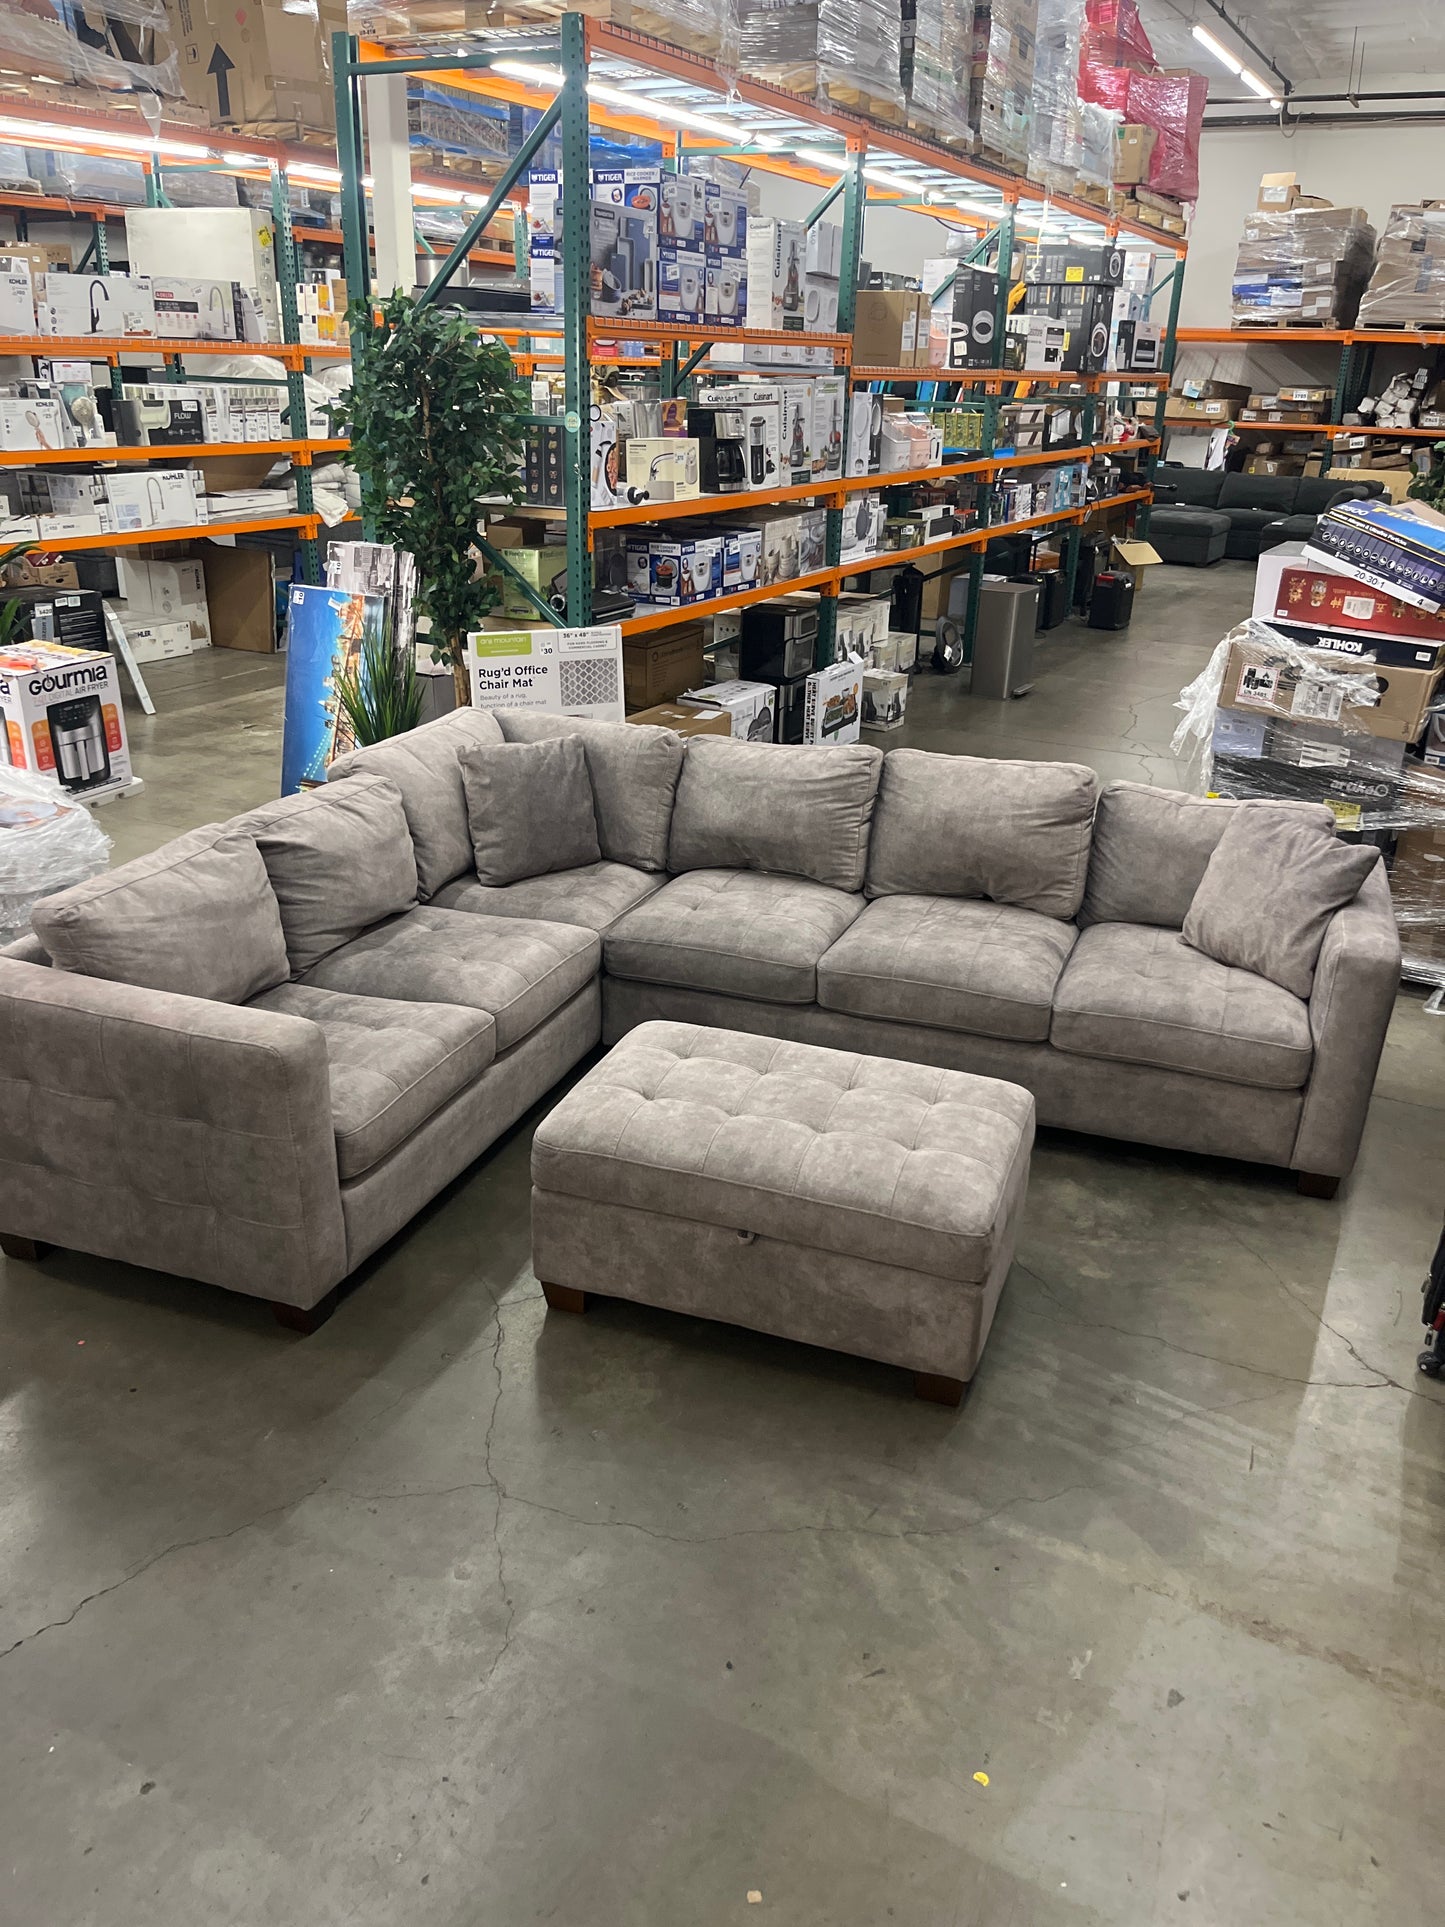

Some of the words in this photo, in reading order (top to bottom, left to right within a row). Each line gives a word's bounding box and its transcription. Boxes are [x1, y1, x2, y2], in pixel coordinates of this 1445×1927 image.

[774, 223, 782, 278] Cuisinart
[707, 394, 738, 402] Cuisinart
[753, 392, 773, 401] Cuisinart
[173, 412, 191, 420] FLOW
[298, 592, 304, 600] 10
[1318, 636, 1362, 653] KOHLER
[478, 668, 511, 679] Rug'd
[514, 665, 548, 676] Office
[75, 686, 86, 695] AIR
[88, 681, 109, 692] FRYER
[479, 678, 509, 690] Chair
[512, 678, 533, 688] Mat
